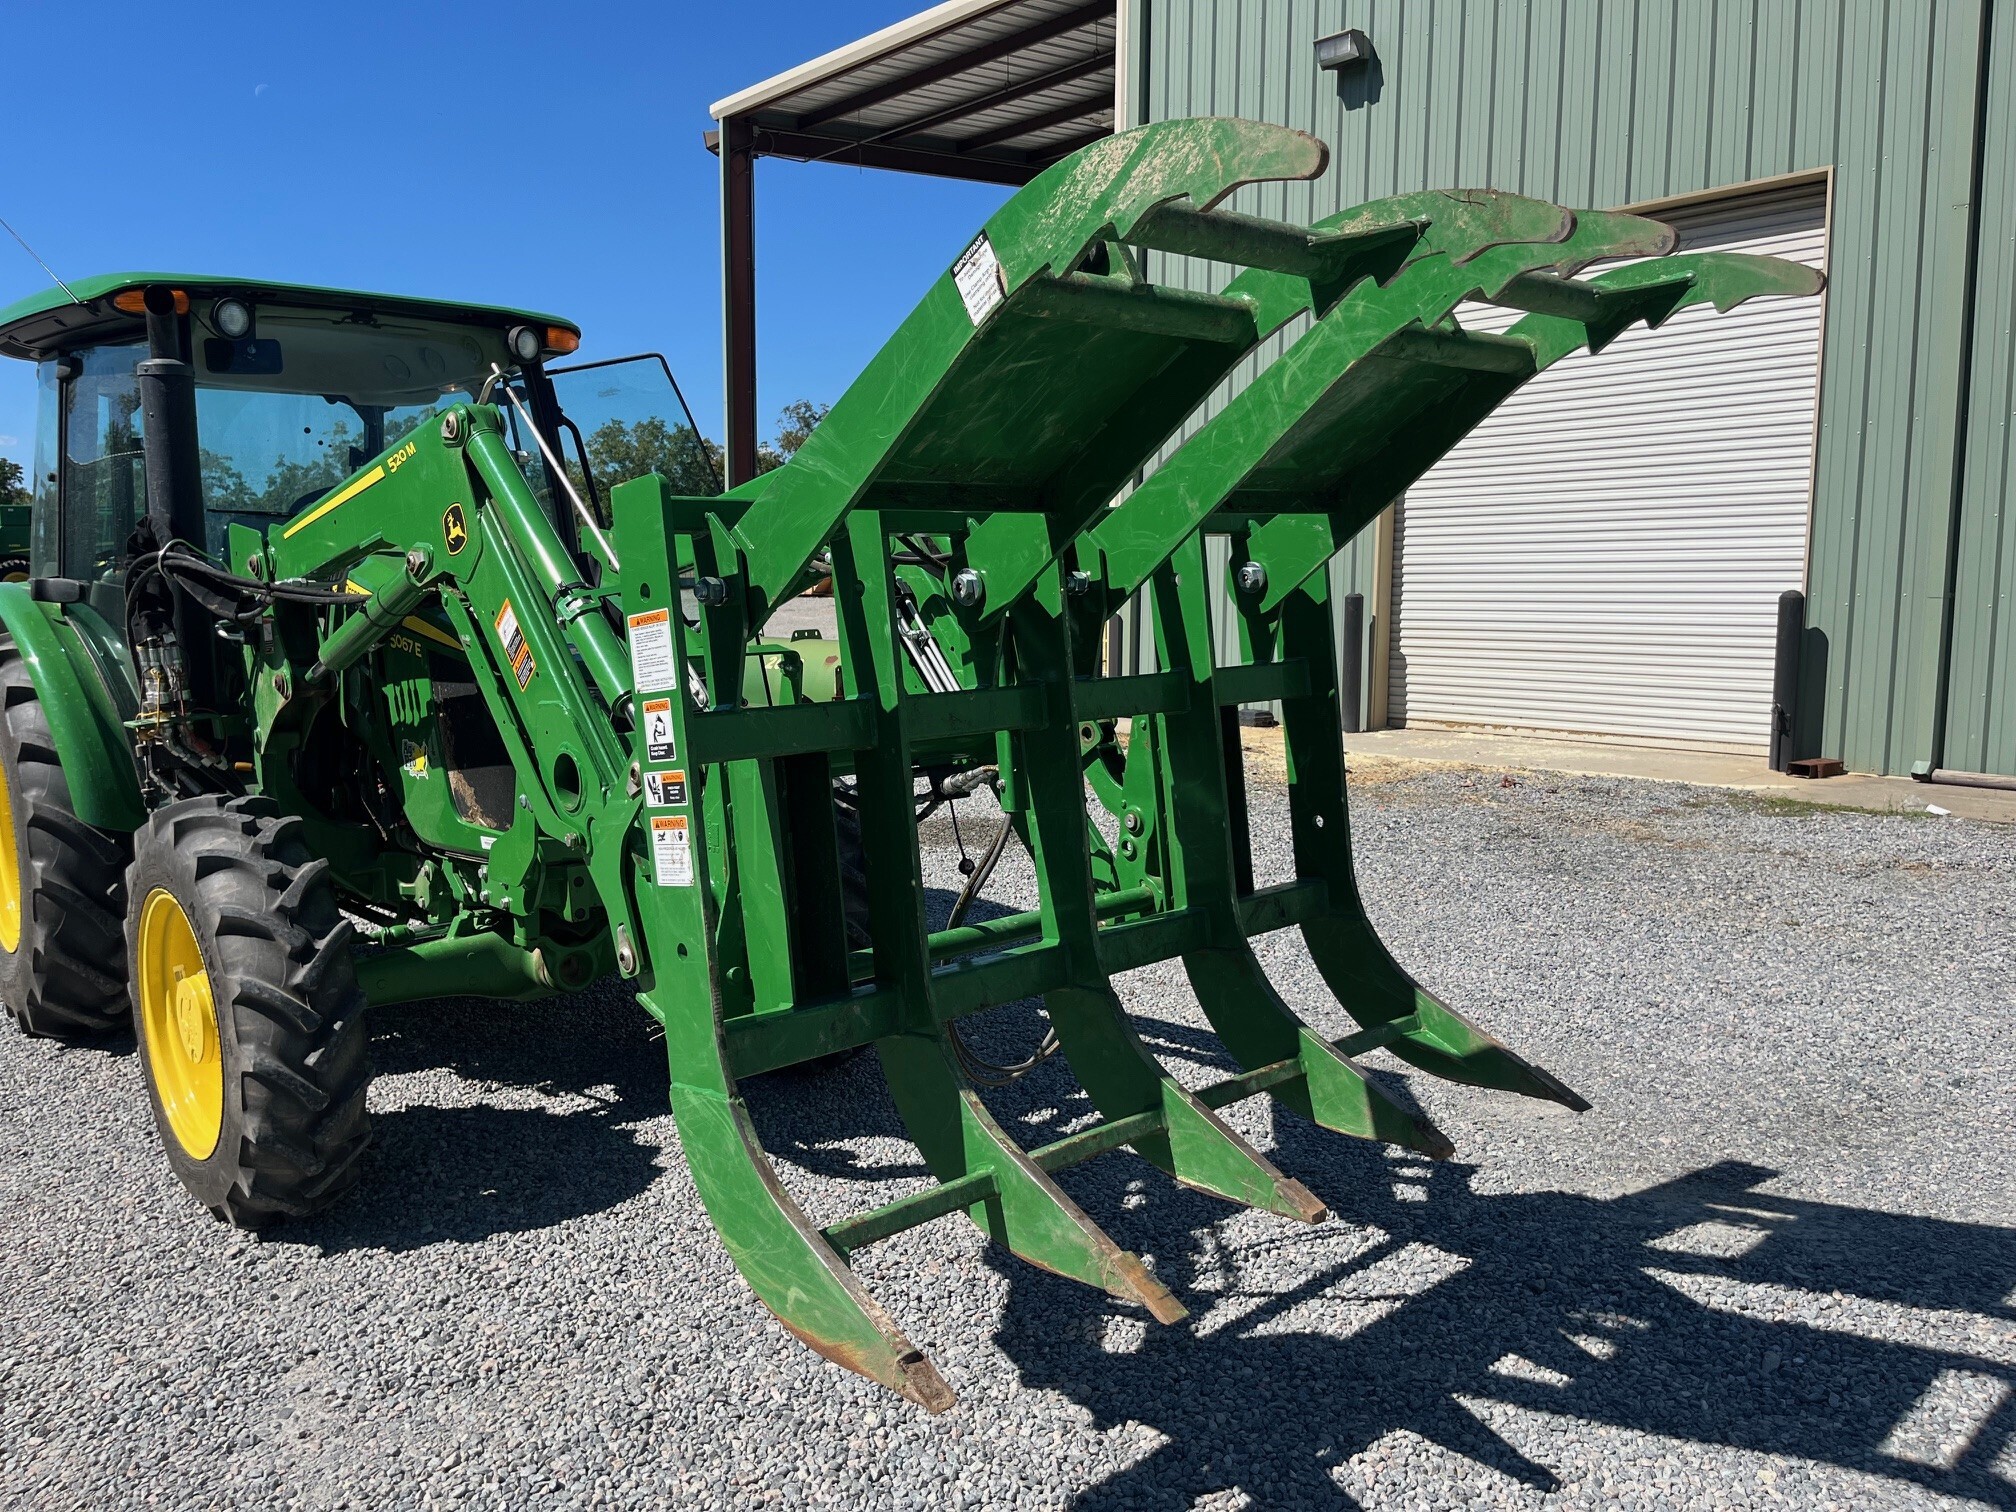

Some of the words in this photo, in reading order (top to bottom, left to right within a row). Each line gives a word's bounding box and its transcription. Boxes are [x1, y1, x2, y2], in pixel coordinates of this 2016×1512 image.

[952, 233, 984, 274] IMPORTANT
[639, 614, 661, 626] WARNING
[649, 702, 668, 711] WARNING
[660, 819, 684, 828] WARNING
